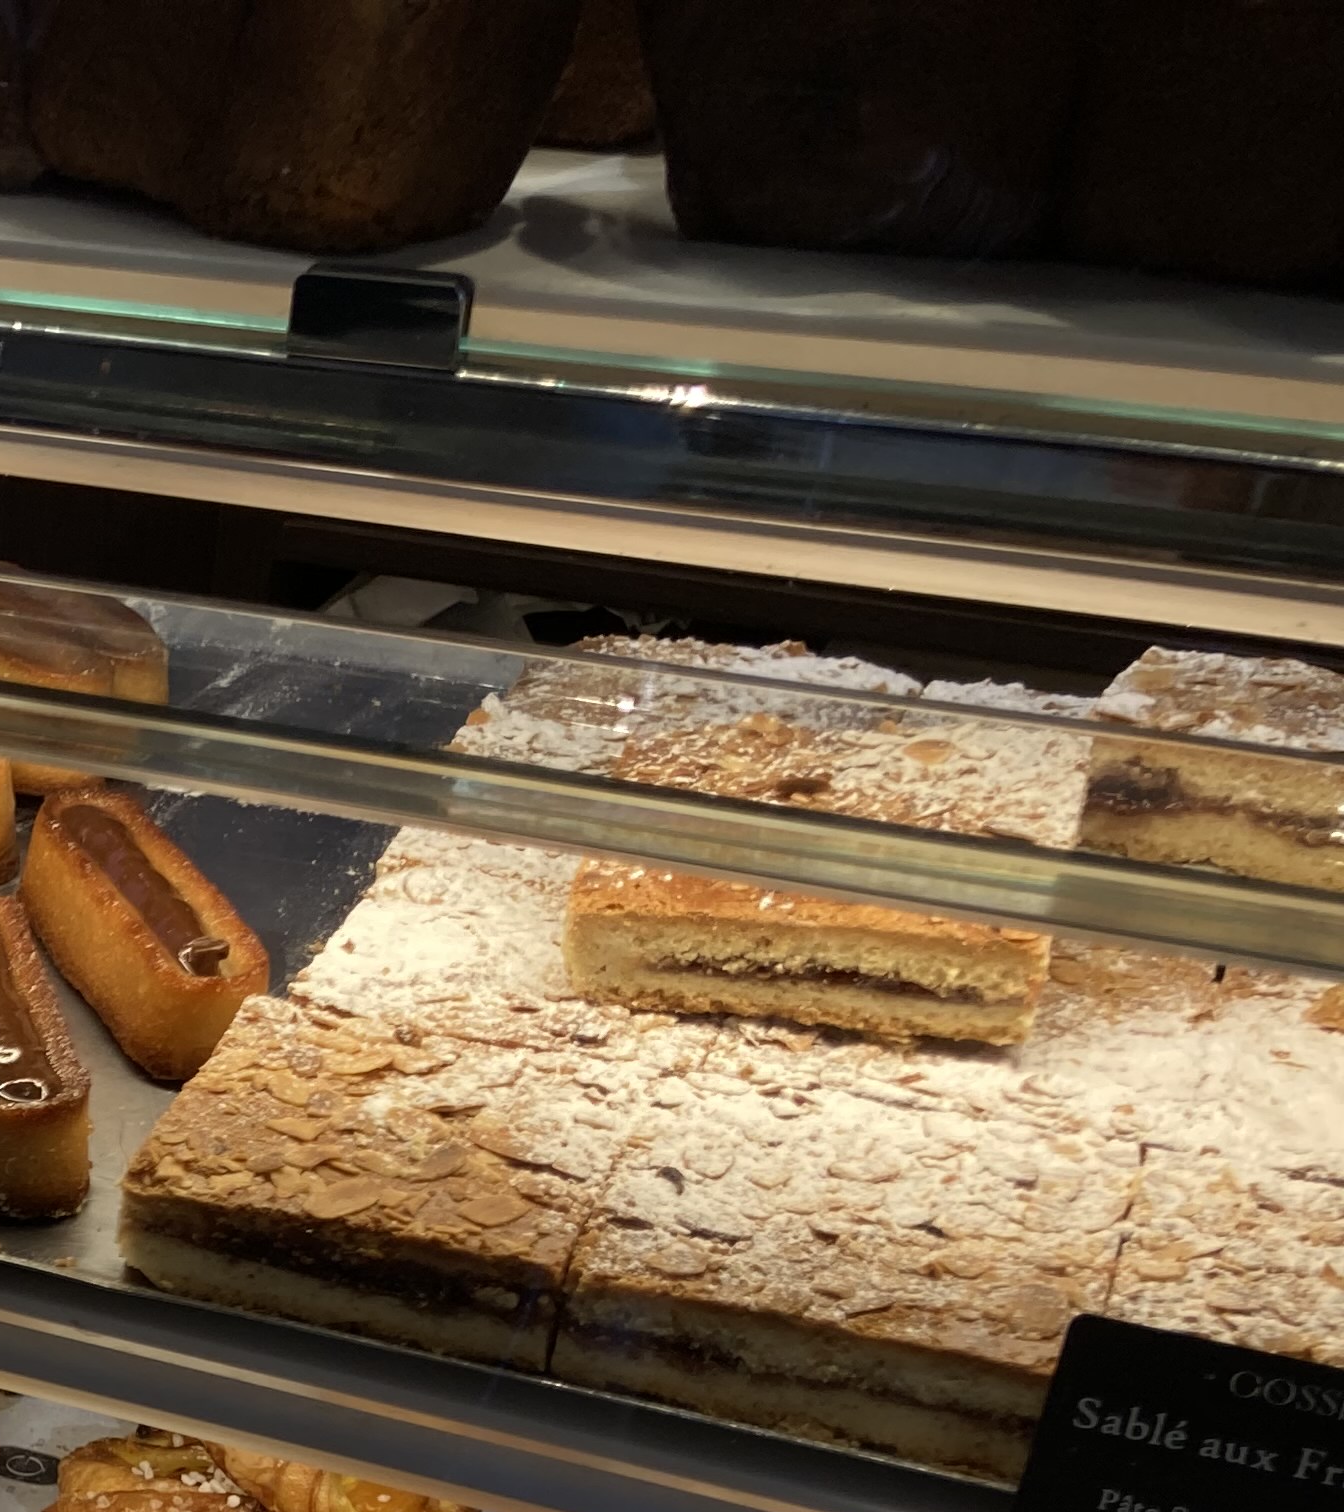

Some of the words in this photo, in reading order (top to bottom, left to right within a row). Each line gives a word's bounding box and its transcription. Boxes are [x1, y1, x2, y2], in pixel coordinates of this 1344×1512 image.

[1229, 1370, 1344, 1420] GOSS
[1072, 1397, 1190, 1450] Sablé
[1198, 1438, 1279, 1473] aux
[1293, 1447, 1344, 1486] Fr
